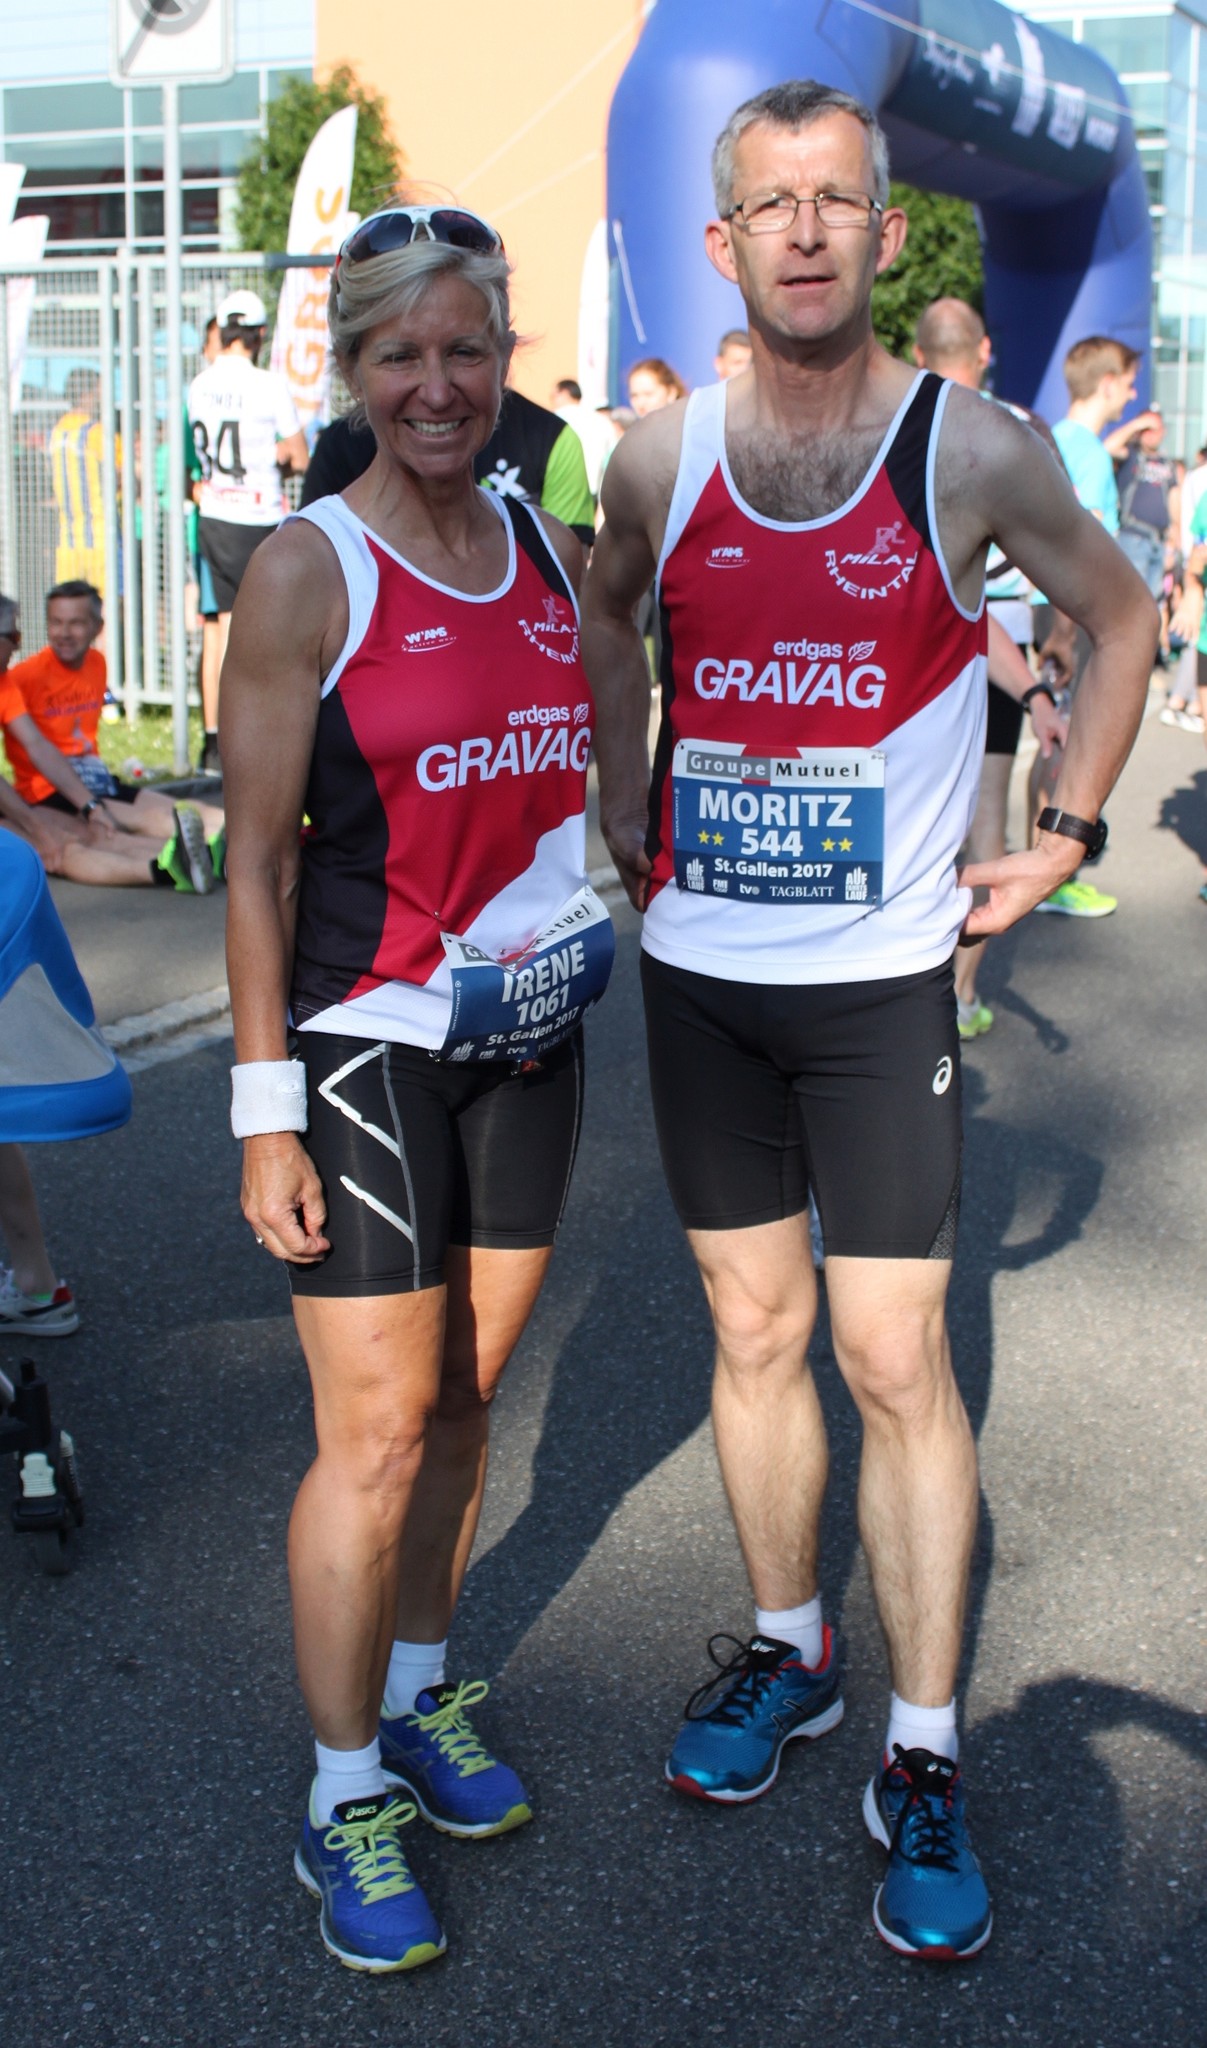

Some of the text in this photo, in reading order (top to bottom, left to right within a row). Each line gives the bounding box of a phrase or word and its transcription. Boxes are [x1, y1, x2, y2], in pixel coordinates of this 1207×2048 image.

[825, 550, 918, 600] RHEINTAL
[404, 626, 448, 645] W'AMS
[773, 638, 843, 661] erdgas
[693, 657, 887, 709] GRAVAG
[508, 704, 570, 727] erdgas
[416, 726, 592, 793] GRAVAG
[689, 754, 860, 778] Groupe Mutuel
[698, 787, 853, 827] MORITZ
[740, 828, 804, 857] 544
[714, 858, 833, 878] St. Gallen 2017
[845, 866, 868, 885] AUF
[769, 885, 835, 898] TAGBLATT
[501, 940, 585, 1003] IRENE
[516, 983, 570, 1026] 1061
[486, 1033, 507, 1046] St.
[509, 1021, 553, 1042] Gallen
[553, 1006, 580, 1030] 2017
